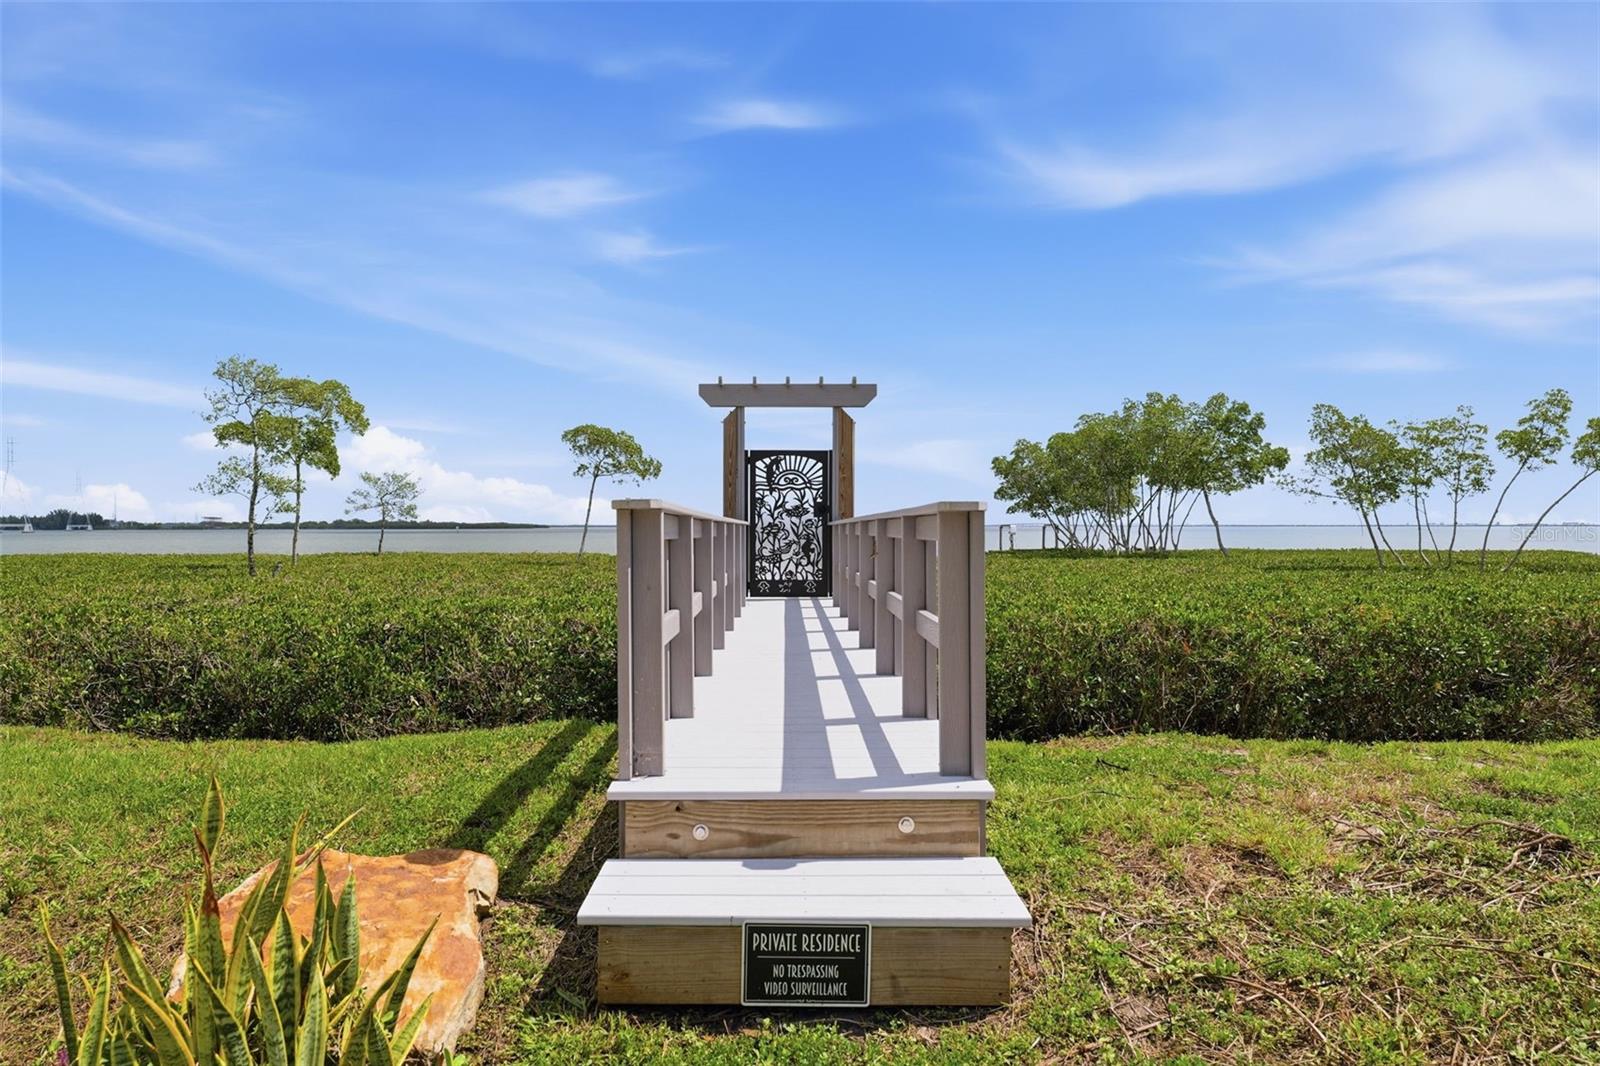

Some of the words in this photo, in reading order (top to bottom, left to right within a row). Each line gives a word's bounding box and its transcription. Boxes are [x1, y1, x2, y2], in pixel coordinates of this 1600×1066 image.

[752, 932, 798, 952] PRIVATE
[801, 933, 861, 953] RESIDENCE
[772, 964, 785, 978] NO
[787, 964, 840, 979] TRESPASSING
[763, 981, 788, 996] VIDEO
[790, 982, 848, 997] SURVEILLANCE
